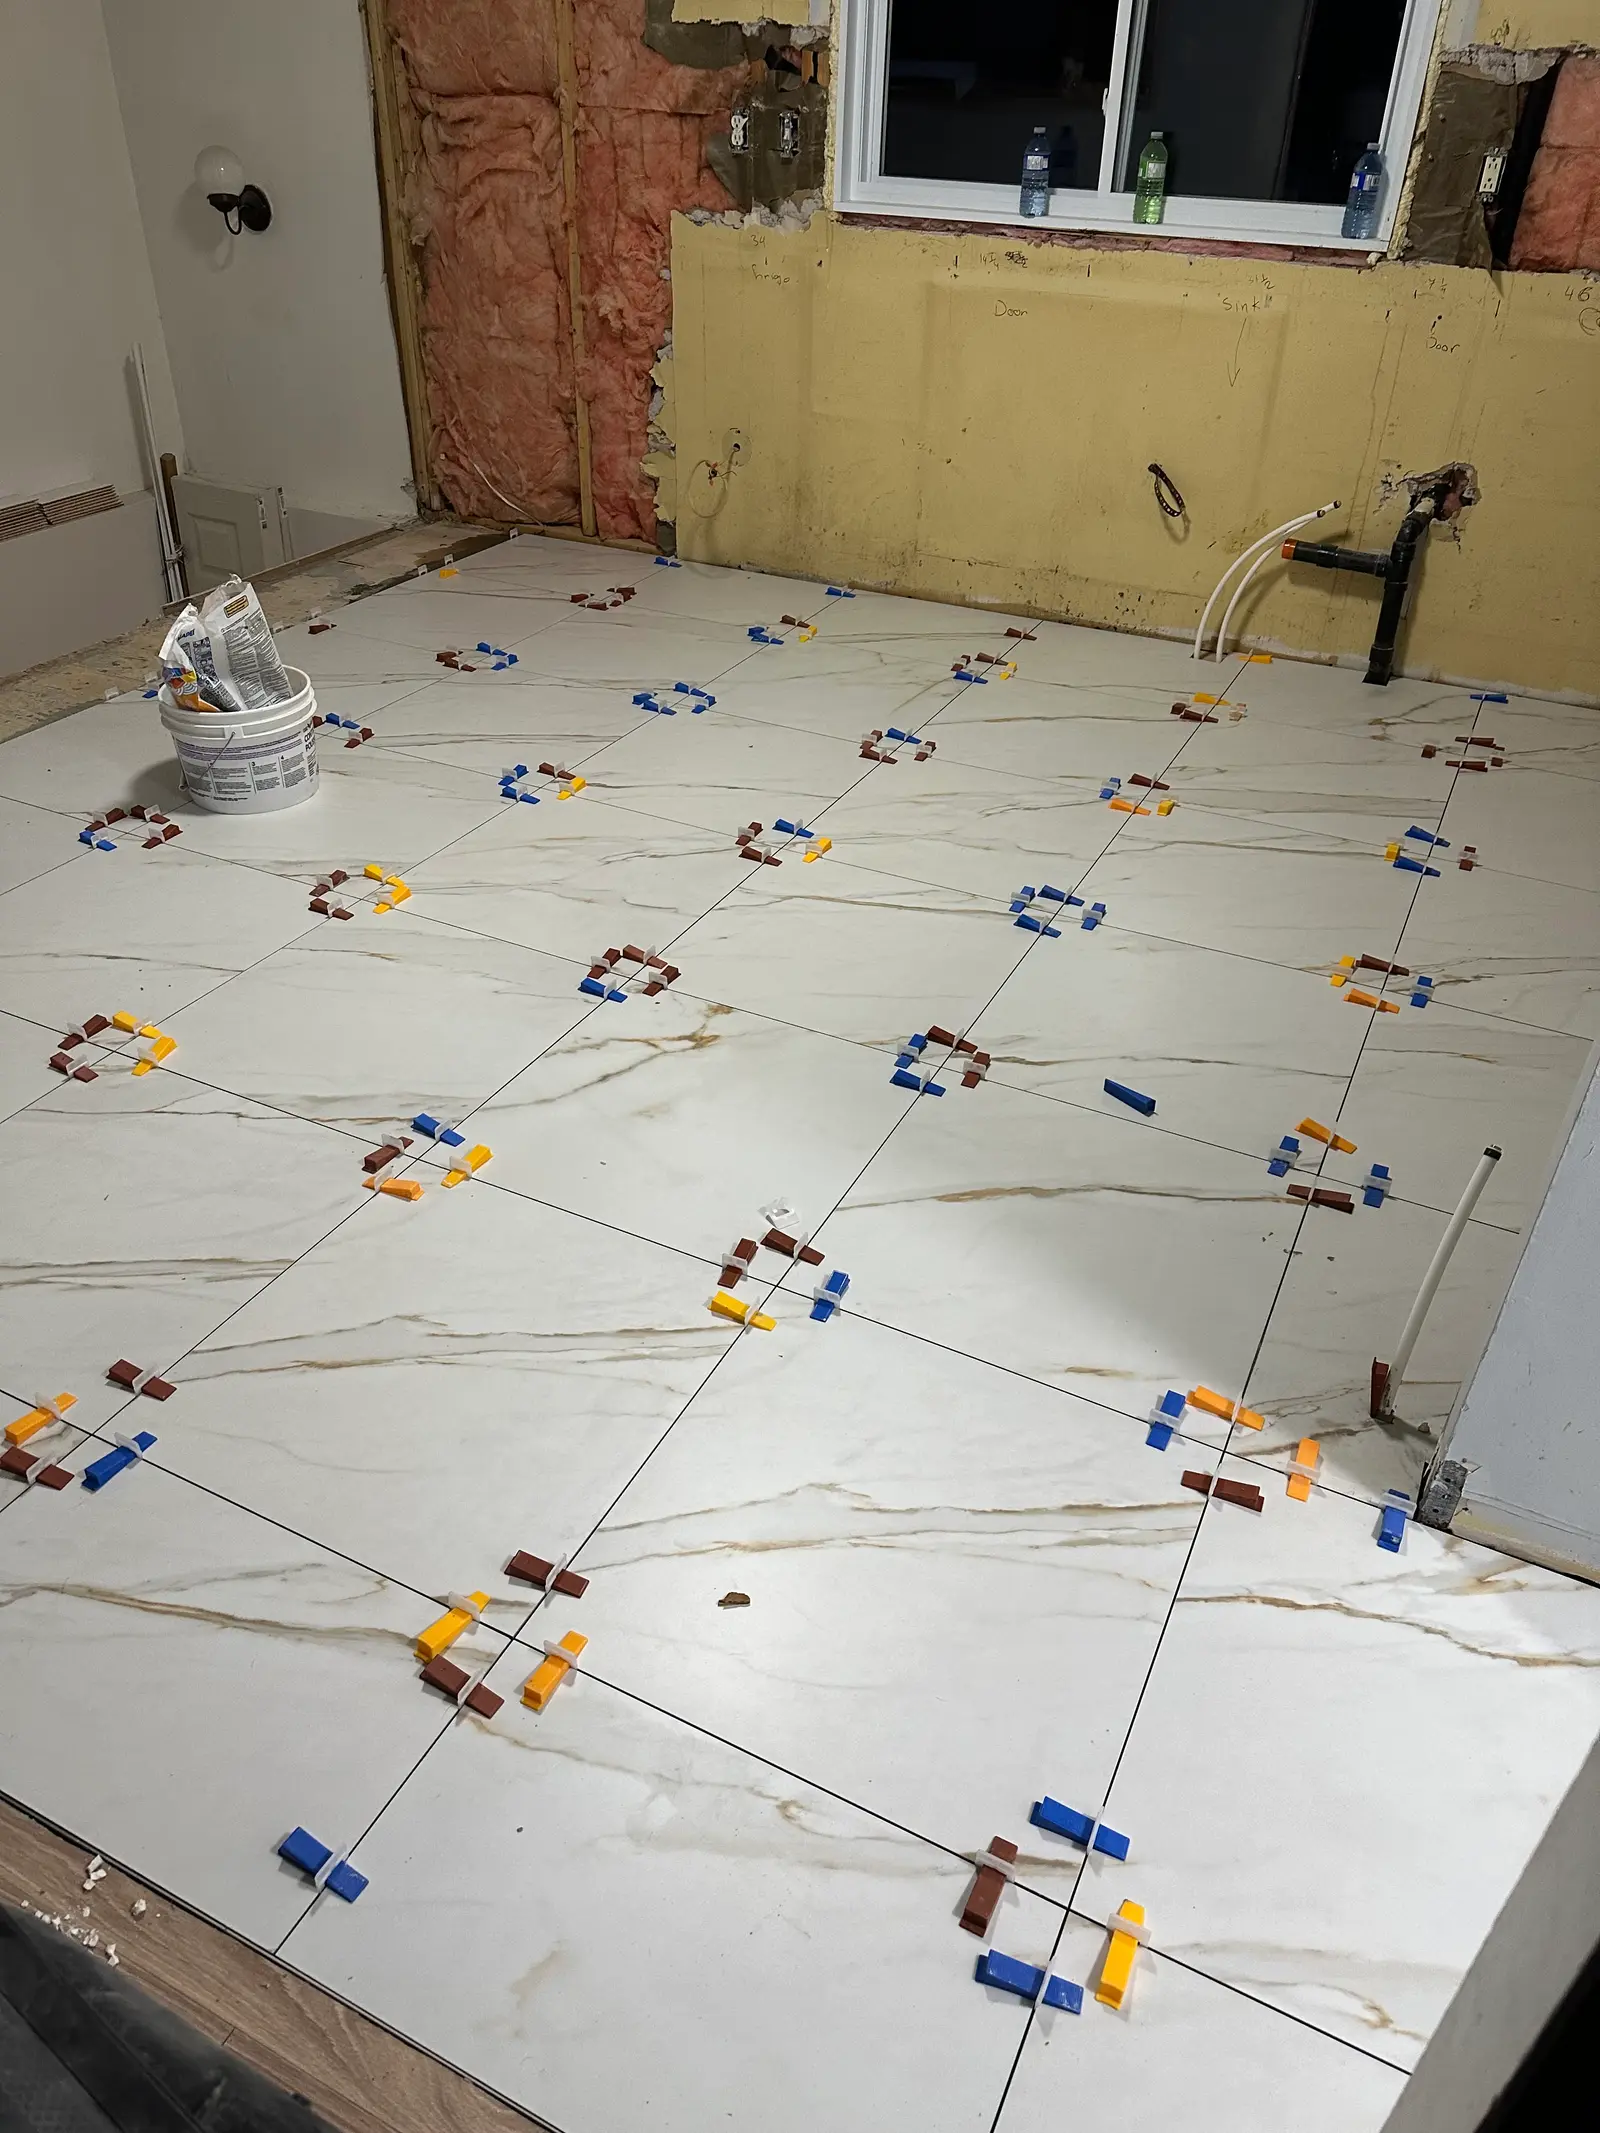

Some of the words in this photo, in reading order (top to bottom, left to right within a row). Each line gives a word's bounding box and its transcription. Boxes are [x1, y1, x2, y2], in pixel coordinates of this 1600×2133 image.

[750, 234, 766, 248] 34
[1564, 285, 1594, 302] 46
[994, 299, 1028, 317] Door
[1222, 295, 1261, 313] Sink
[1425, 336, 1461, 353] Door
